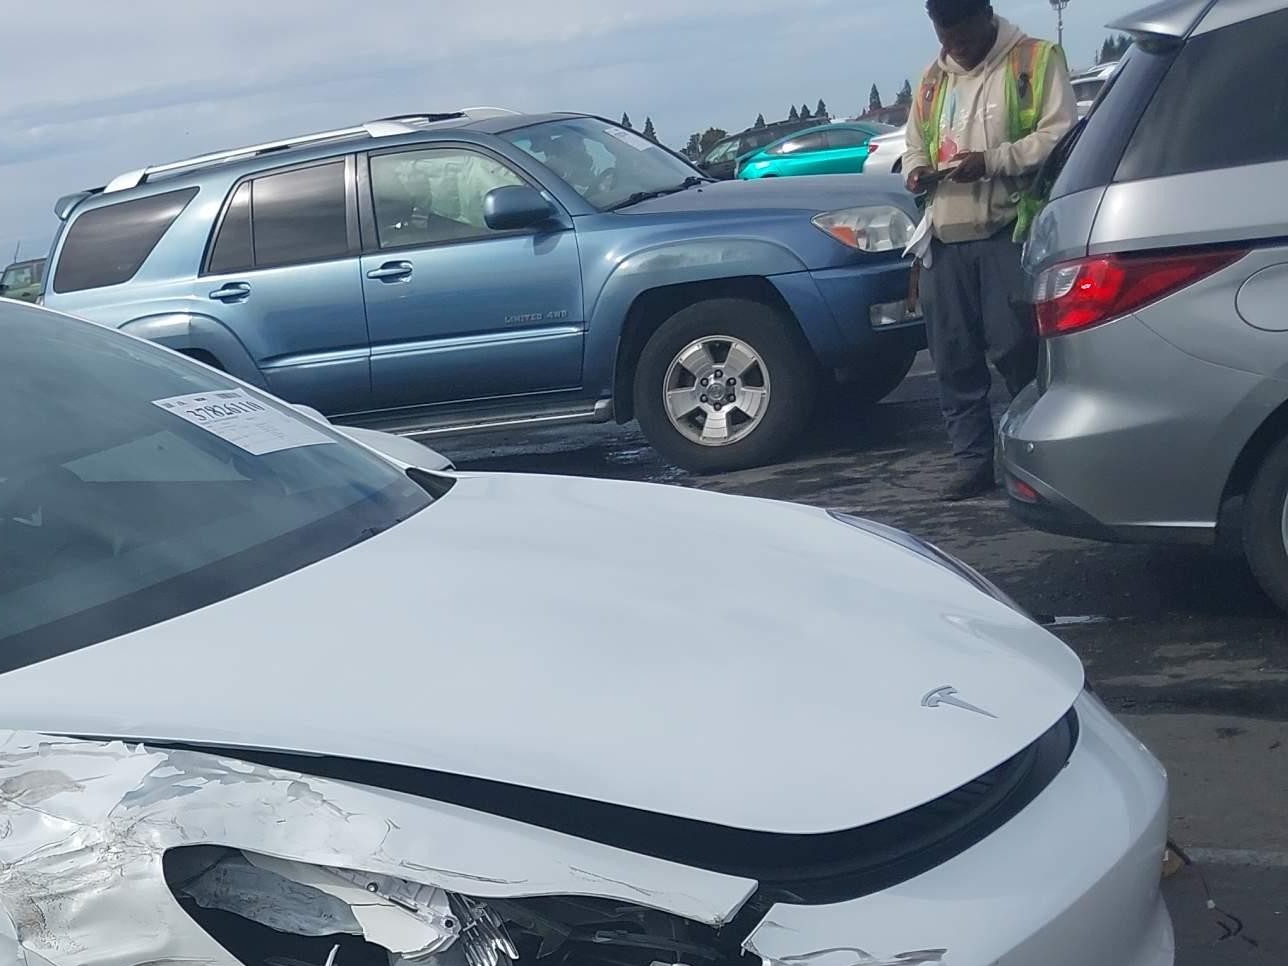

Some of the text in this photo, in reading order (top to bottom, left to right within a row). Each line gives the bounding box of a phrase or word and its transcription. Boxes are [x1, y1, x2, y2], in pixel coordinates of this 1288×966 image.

[504, 309, 567, 323] LIMITED 4WD
[185, 401, 266, 421] 37826110
